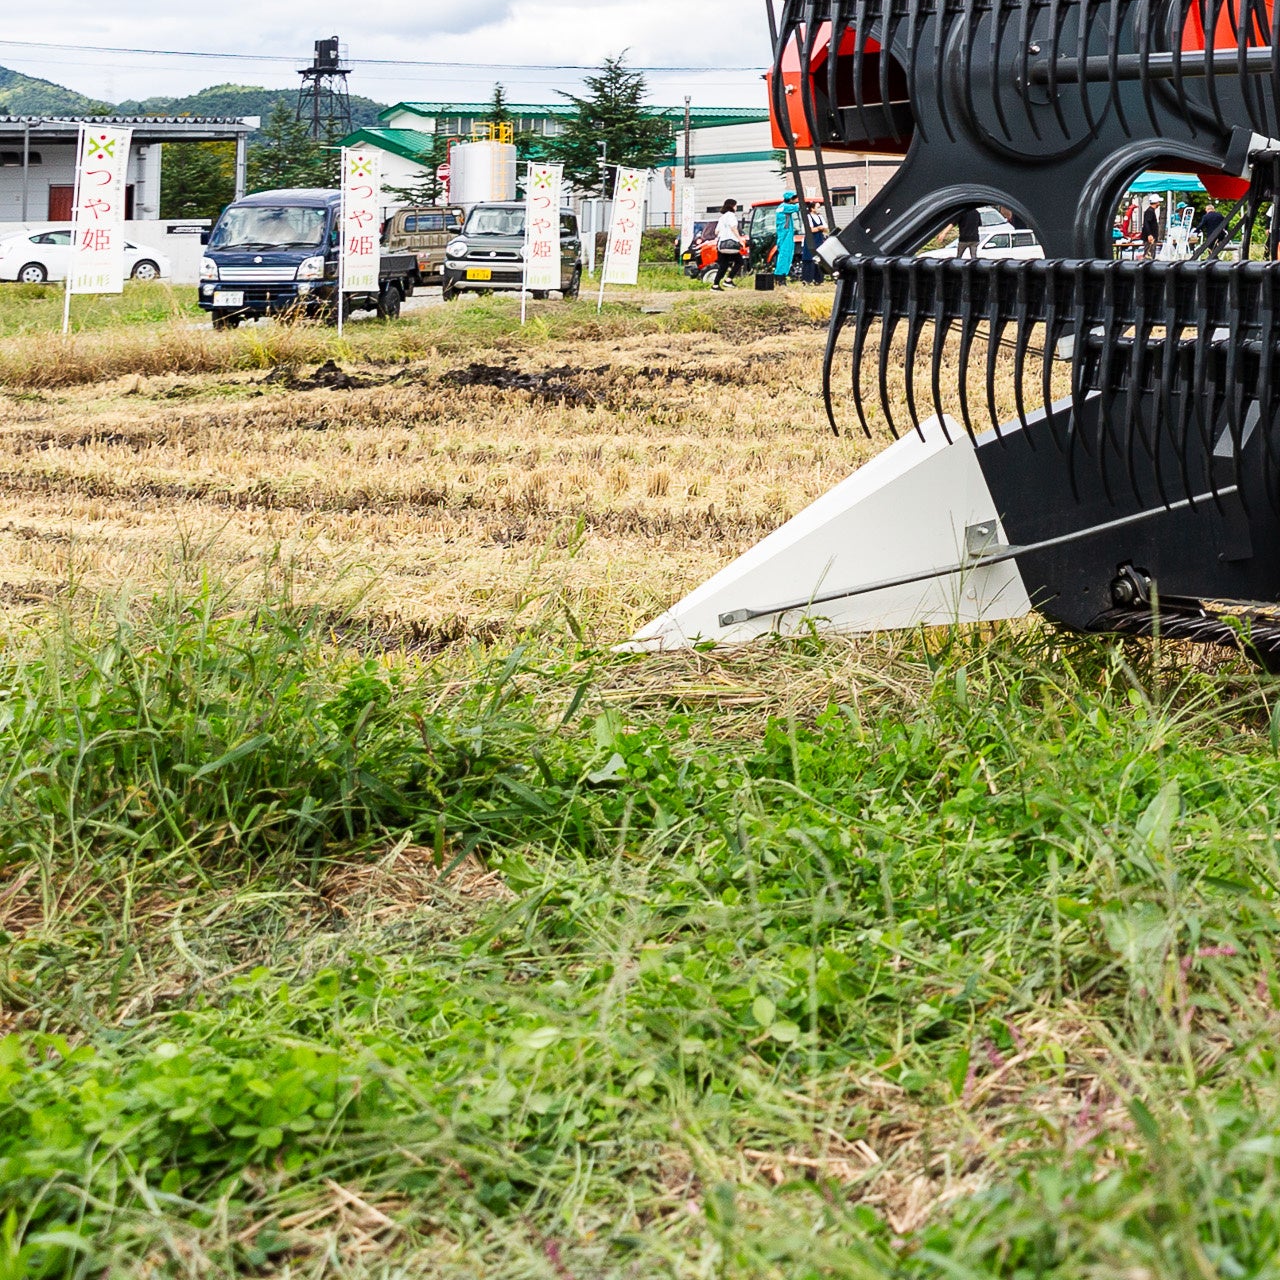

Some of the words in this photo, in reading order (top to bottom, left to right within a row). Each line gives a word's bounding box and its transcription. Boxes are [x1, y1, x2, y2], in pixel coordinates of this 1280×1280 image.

[80, 168, 112, 252] つや姫
[348, 184, 374, 256] つや姫
[532, 196, 551, 258] つや姫
[613, 198, 636, 255] つや姫
